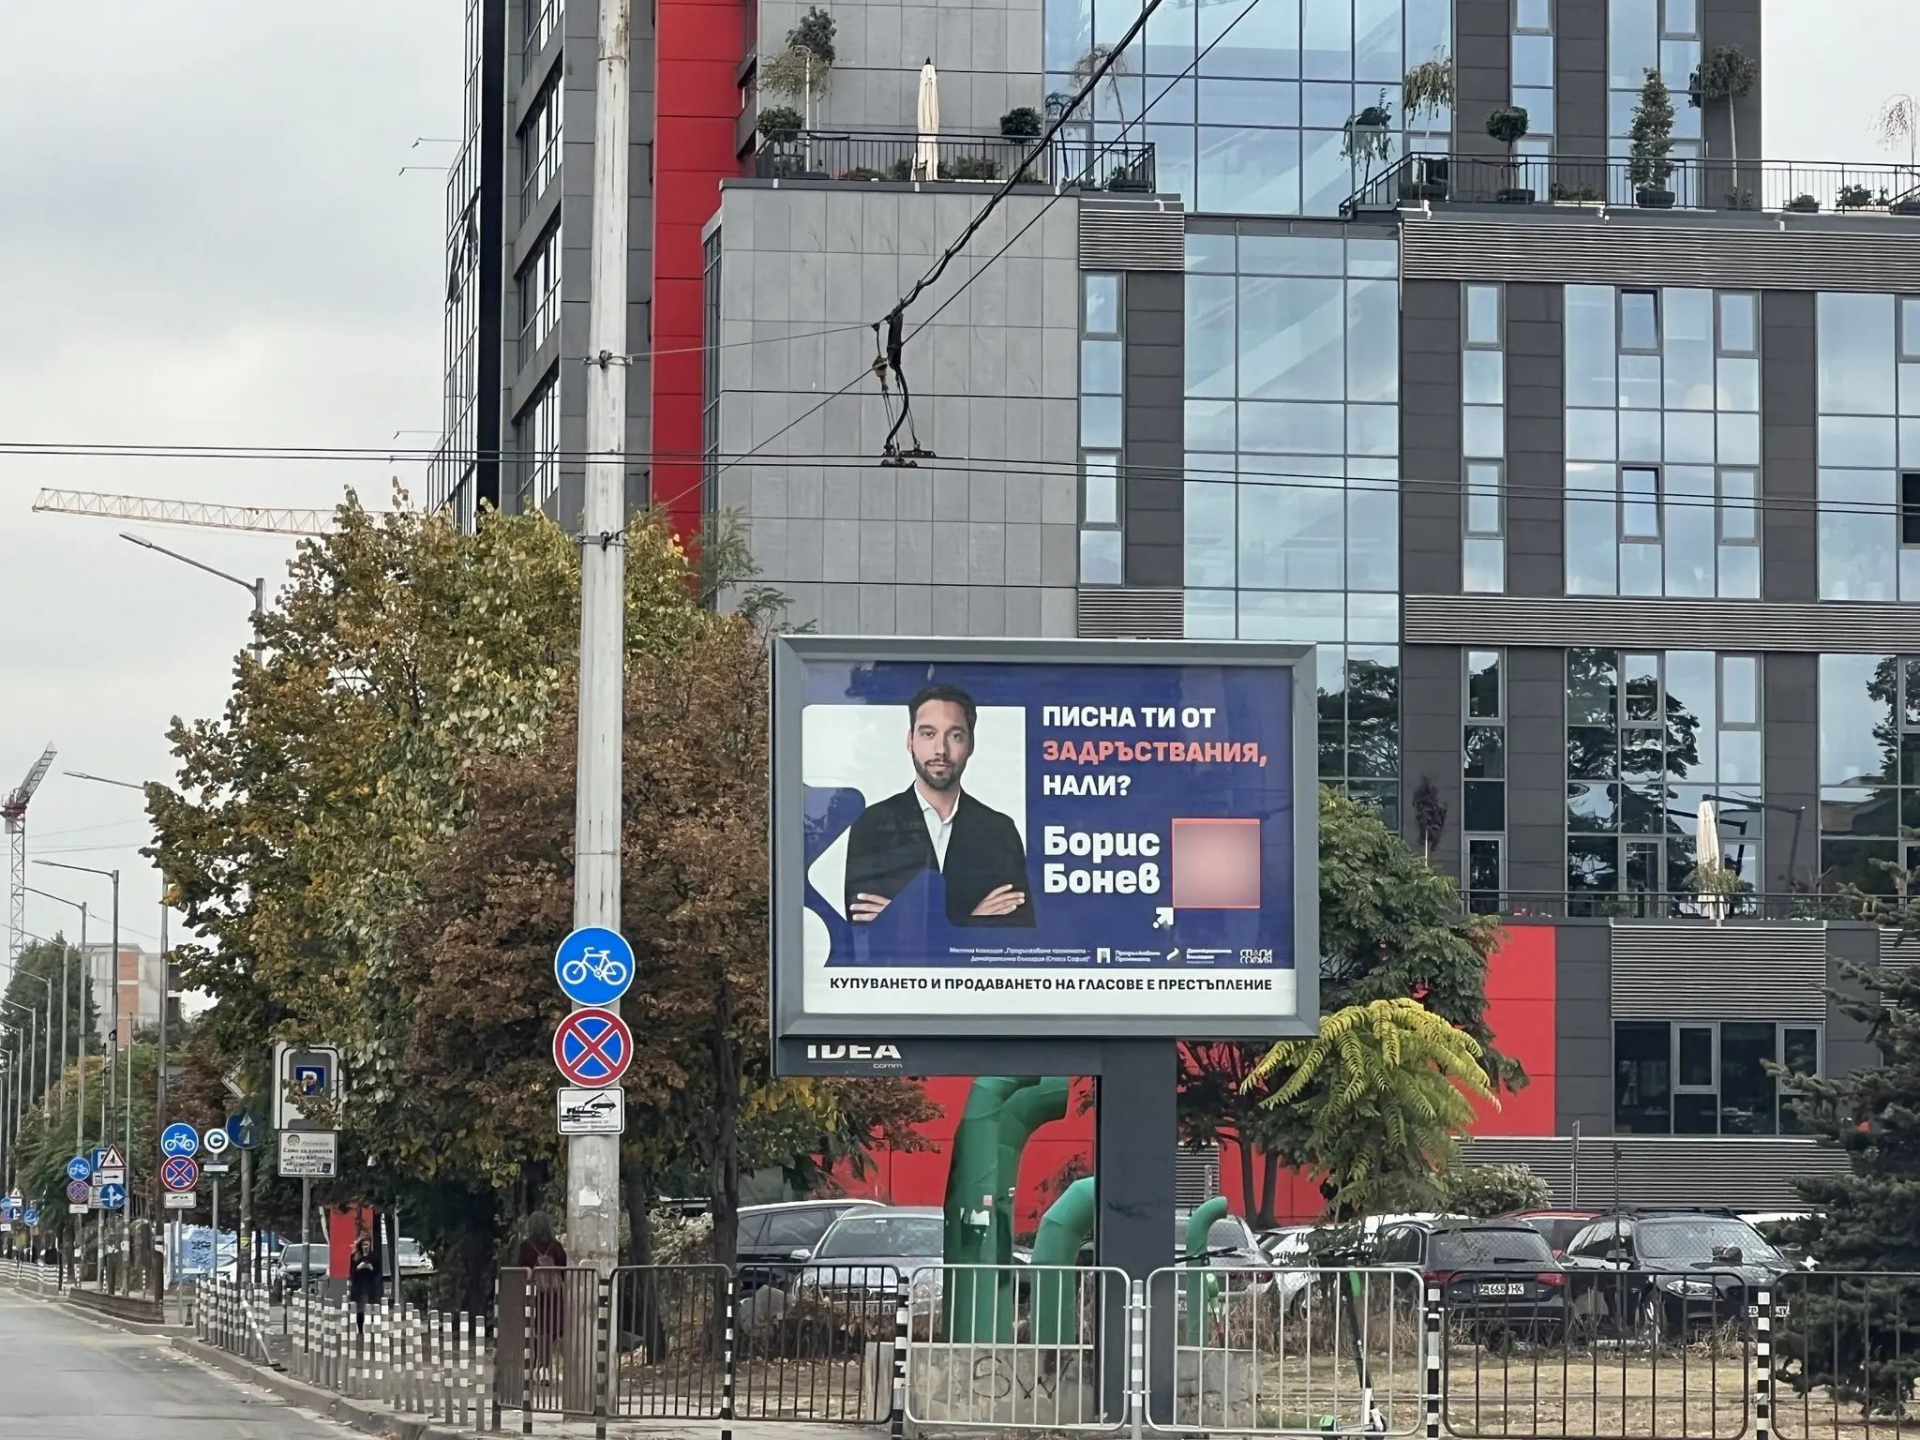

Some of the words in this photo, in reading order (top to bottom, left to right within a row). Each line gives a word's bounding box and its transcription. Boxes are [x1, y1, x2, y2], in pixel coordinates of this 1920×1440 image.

[1043, 706, 1136, 728] ПИСНА
[1141, 707, 1176, 728] ТИ
[1181, 708, 1216, 729] ОТ
[1042, 740, 1268, 768] ЗАДРЪСТВАНИЯ,
[1043, 775, 1132, 796] НАЛИ?
[1044, 825, 1160, 863] Борис
[1044, 862, 1160, 894] Бонев
[830, 978, 928, 989] КУПУВАНЕТО
[931, 978, 941, 989] И
[944, 978, 1052, 991] ПРОДАВАНЕТО
[1055, 979, 1076, 990] НА
[1078, 979, 1144, 990] ГЛАСОВЕ
[1147, 979, 1155, 990] Е
[1158, 979, 1273, 990] ПРЕСТЪПЛЕНИЕ
[807, 1044, 902, 1059] IDEA
